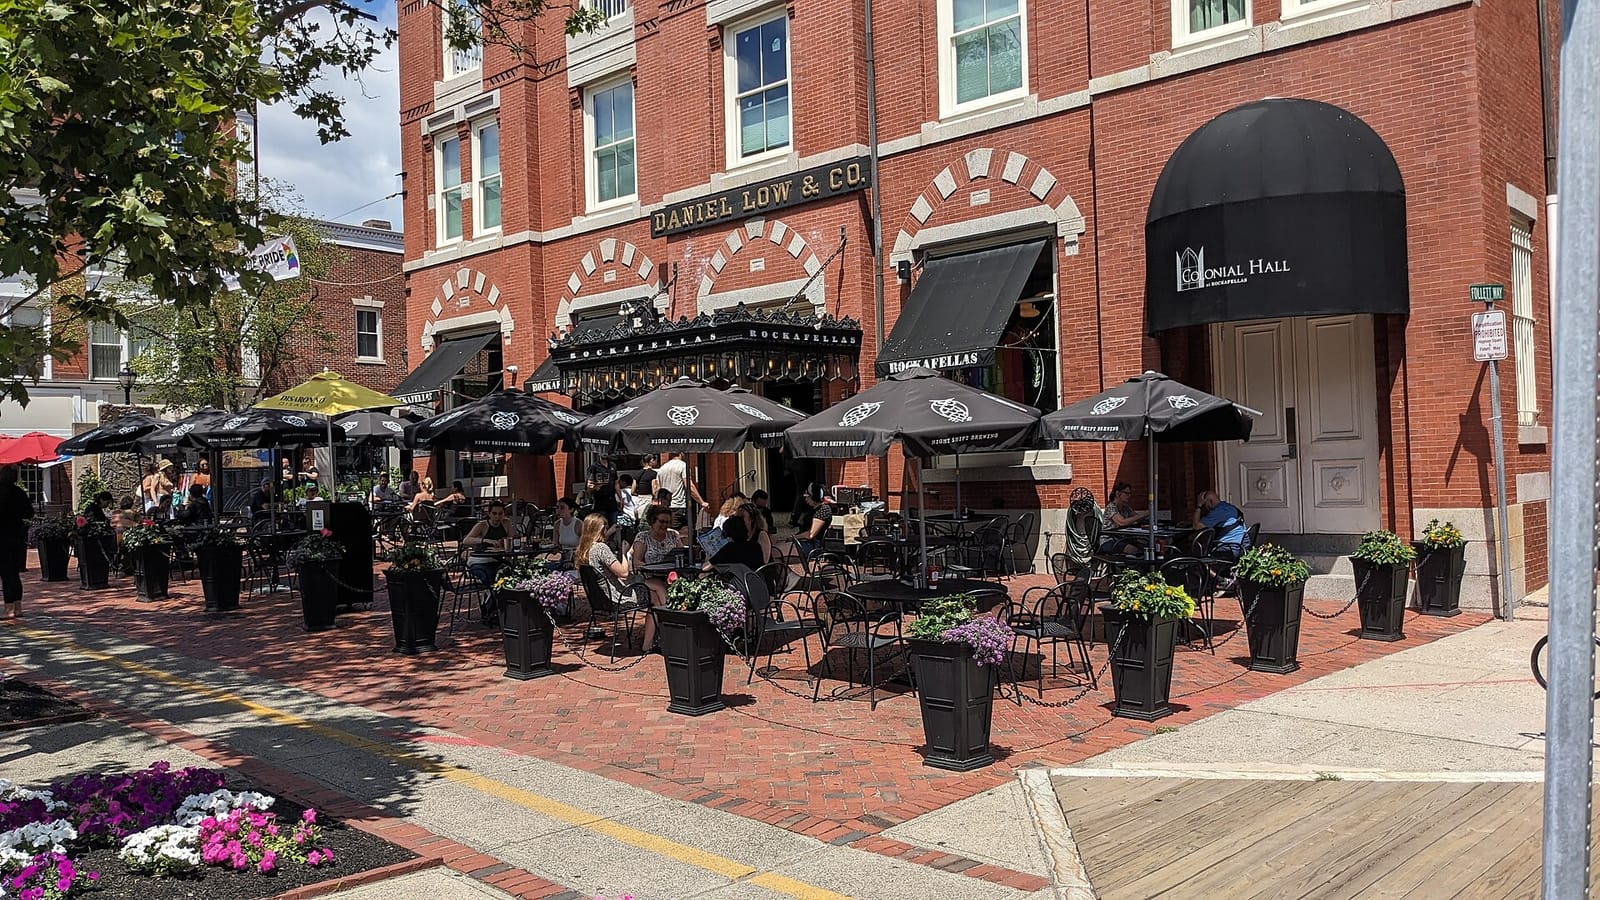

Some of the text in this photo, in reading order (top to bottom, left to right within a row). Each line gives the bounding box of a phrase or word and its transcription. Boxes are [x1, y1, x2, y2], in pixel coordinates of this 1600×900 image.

[654, 163, 866, 233] DANIEL LOW & CO.
[1211, 278, 1248, 287] ROCKAFELLAS
[1471, 287, 1503, 300] FOLLETT WAY
[633, 317, 643, 329] R
[749, 330, 856, 344] ROCKAFELLAS
[1474, 328, 1504, 339] PROHIBITED
[569, 333, 716, 360] ROCKAFELLAS
[889, 352, 978, 374] ROCKAFELLAS
[931, 438, 950, 446] NIGHT
[970, 433, 999, 441] BREWING
